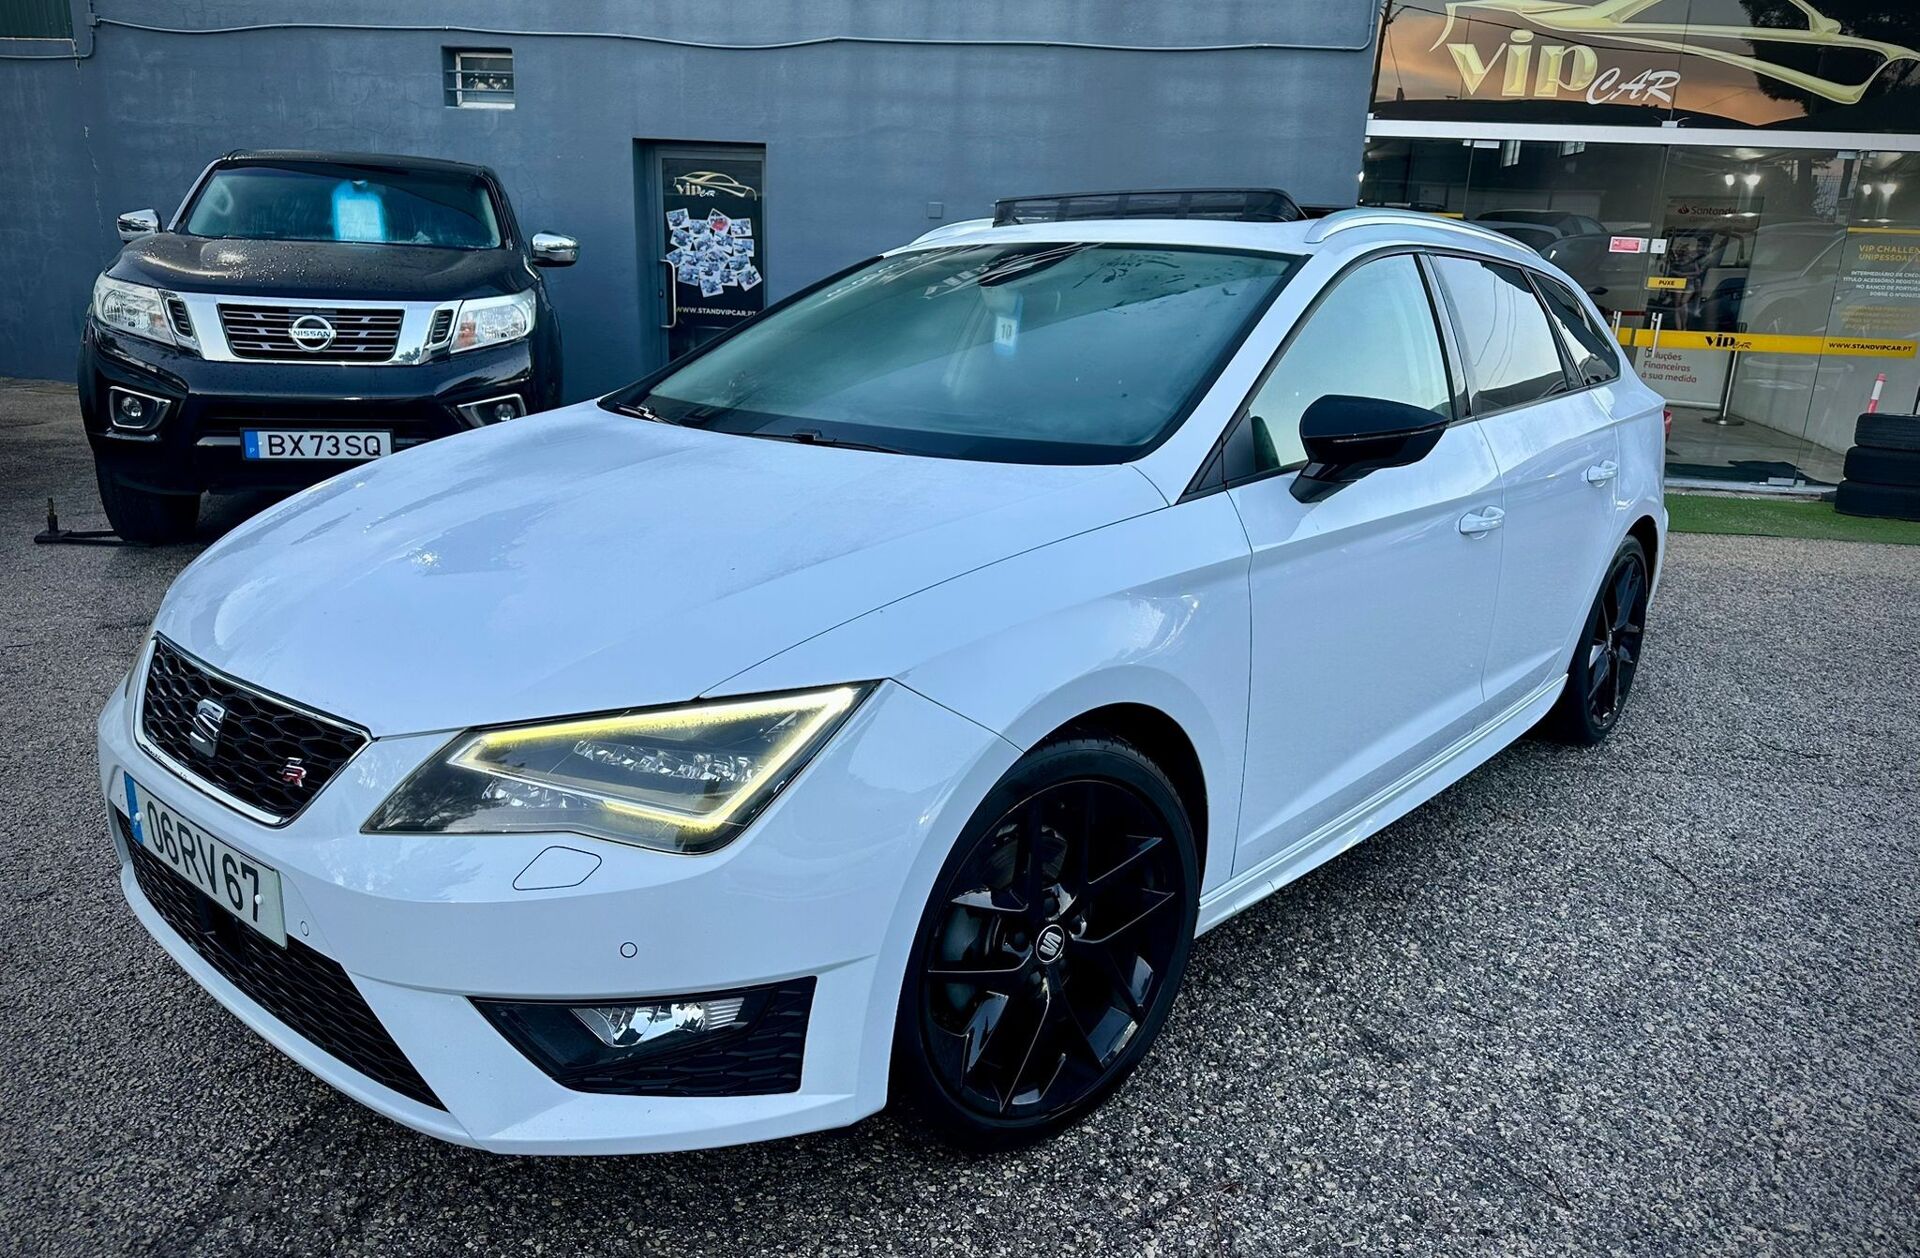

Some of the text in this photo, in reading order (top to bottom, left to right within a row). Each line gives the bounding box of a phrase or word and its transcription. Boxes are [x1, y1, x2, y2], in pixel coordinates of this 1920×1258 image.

[1586, 67, 1681, 105] CAR
[1859, 244, 1875, 253] VIP
[1658, 279, 1675, 287] PUXE
[675, 306, 757, 317] WWW.STANDVIPCAR.PT
[293, 329, 331, 339] NISSAN
[1828, 342, 1913, 352] WWW.STANDVIPCAR.PT
[1643, 361, 1691, 373] Financeiras
[1664, 374, 1697, 384] medida
[147, 801, 259, 923] 06RV67
